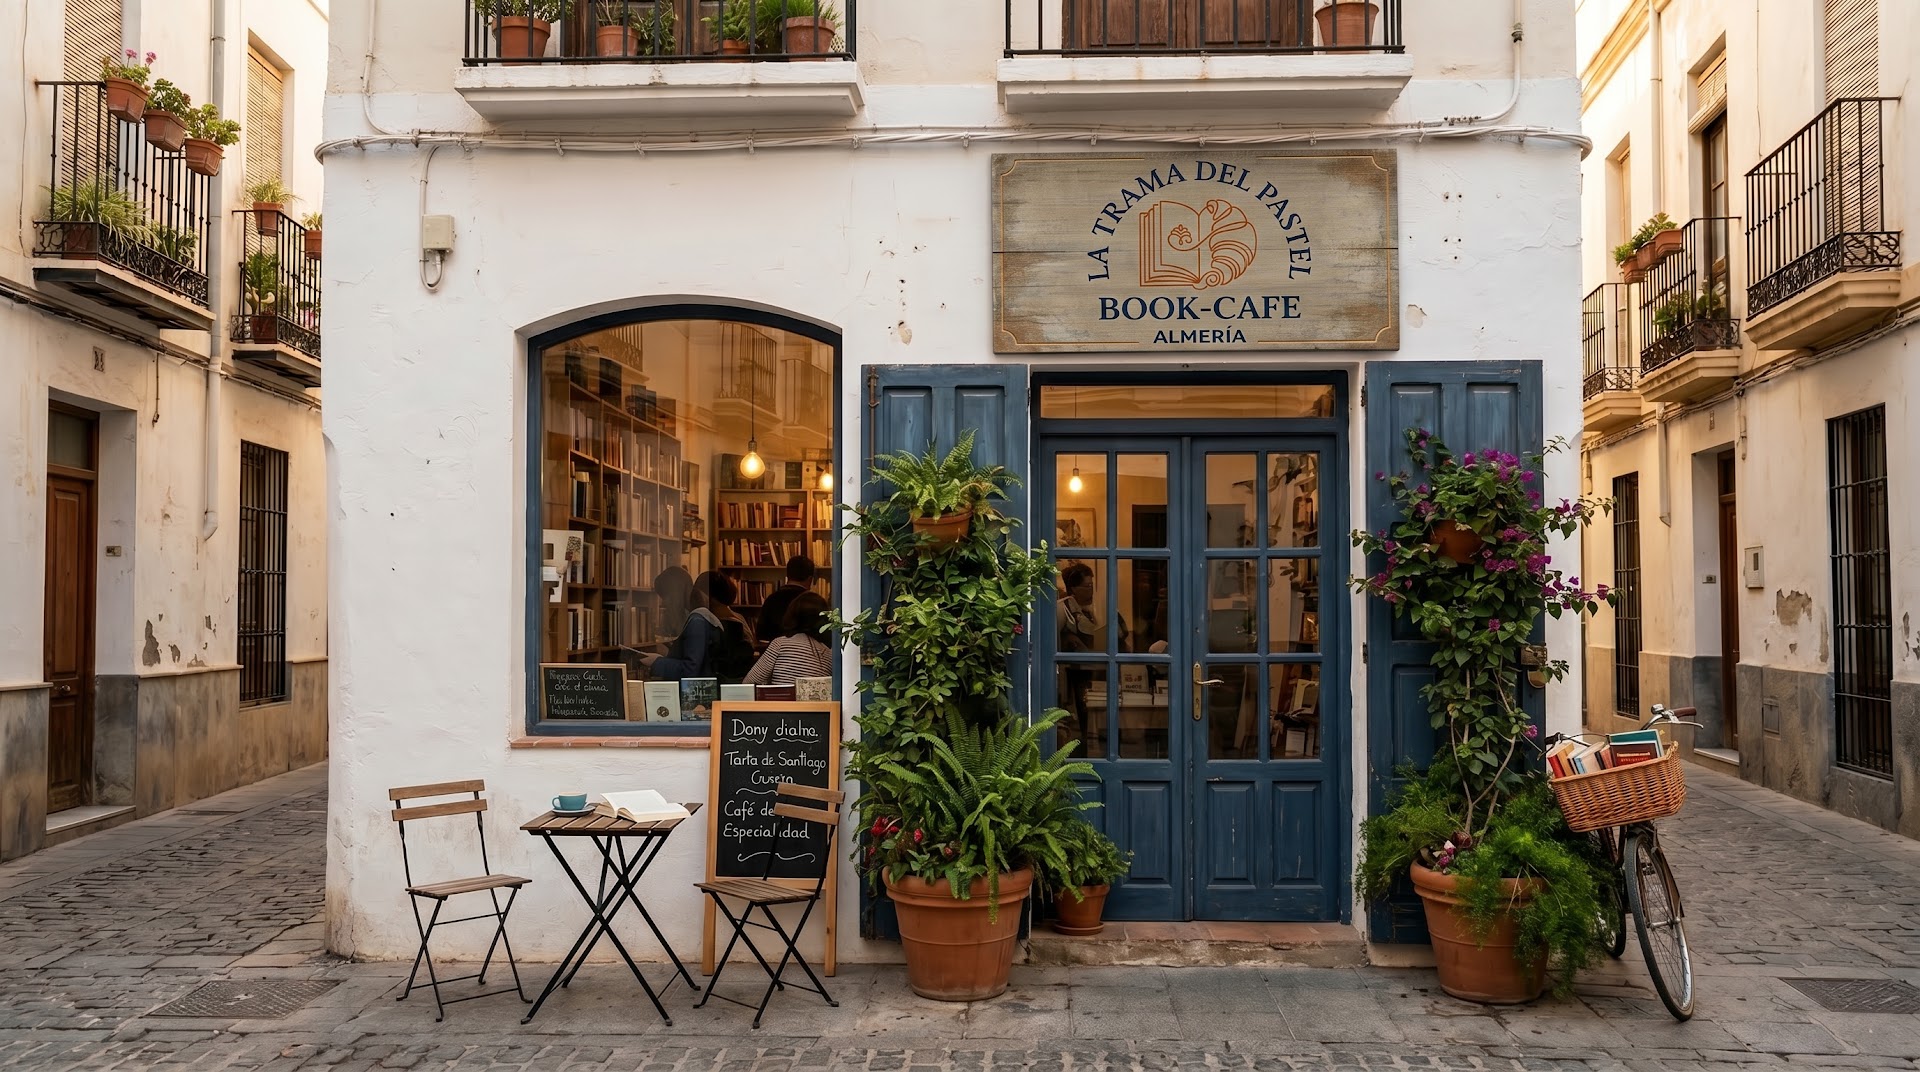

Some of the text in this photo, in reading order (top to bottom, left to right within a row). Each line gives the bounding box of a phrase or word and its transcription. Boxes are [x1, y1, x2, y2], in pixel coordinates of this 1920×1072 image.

[1087, 160, 1312, 282] LA TRAMA DEL PASTEL
[1098, 295, 1302, 321] BOOK-CAFE
[1153, 326, 1247, 344] ALMERÍA
[731, 718, 768, 741] Dony
[724, 750, 827, 776] Tarta de Santiago
[724, 800, 775, 821] Café de
